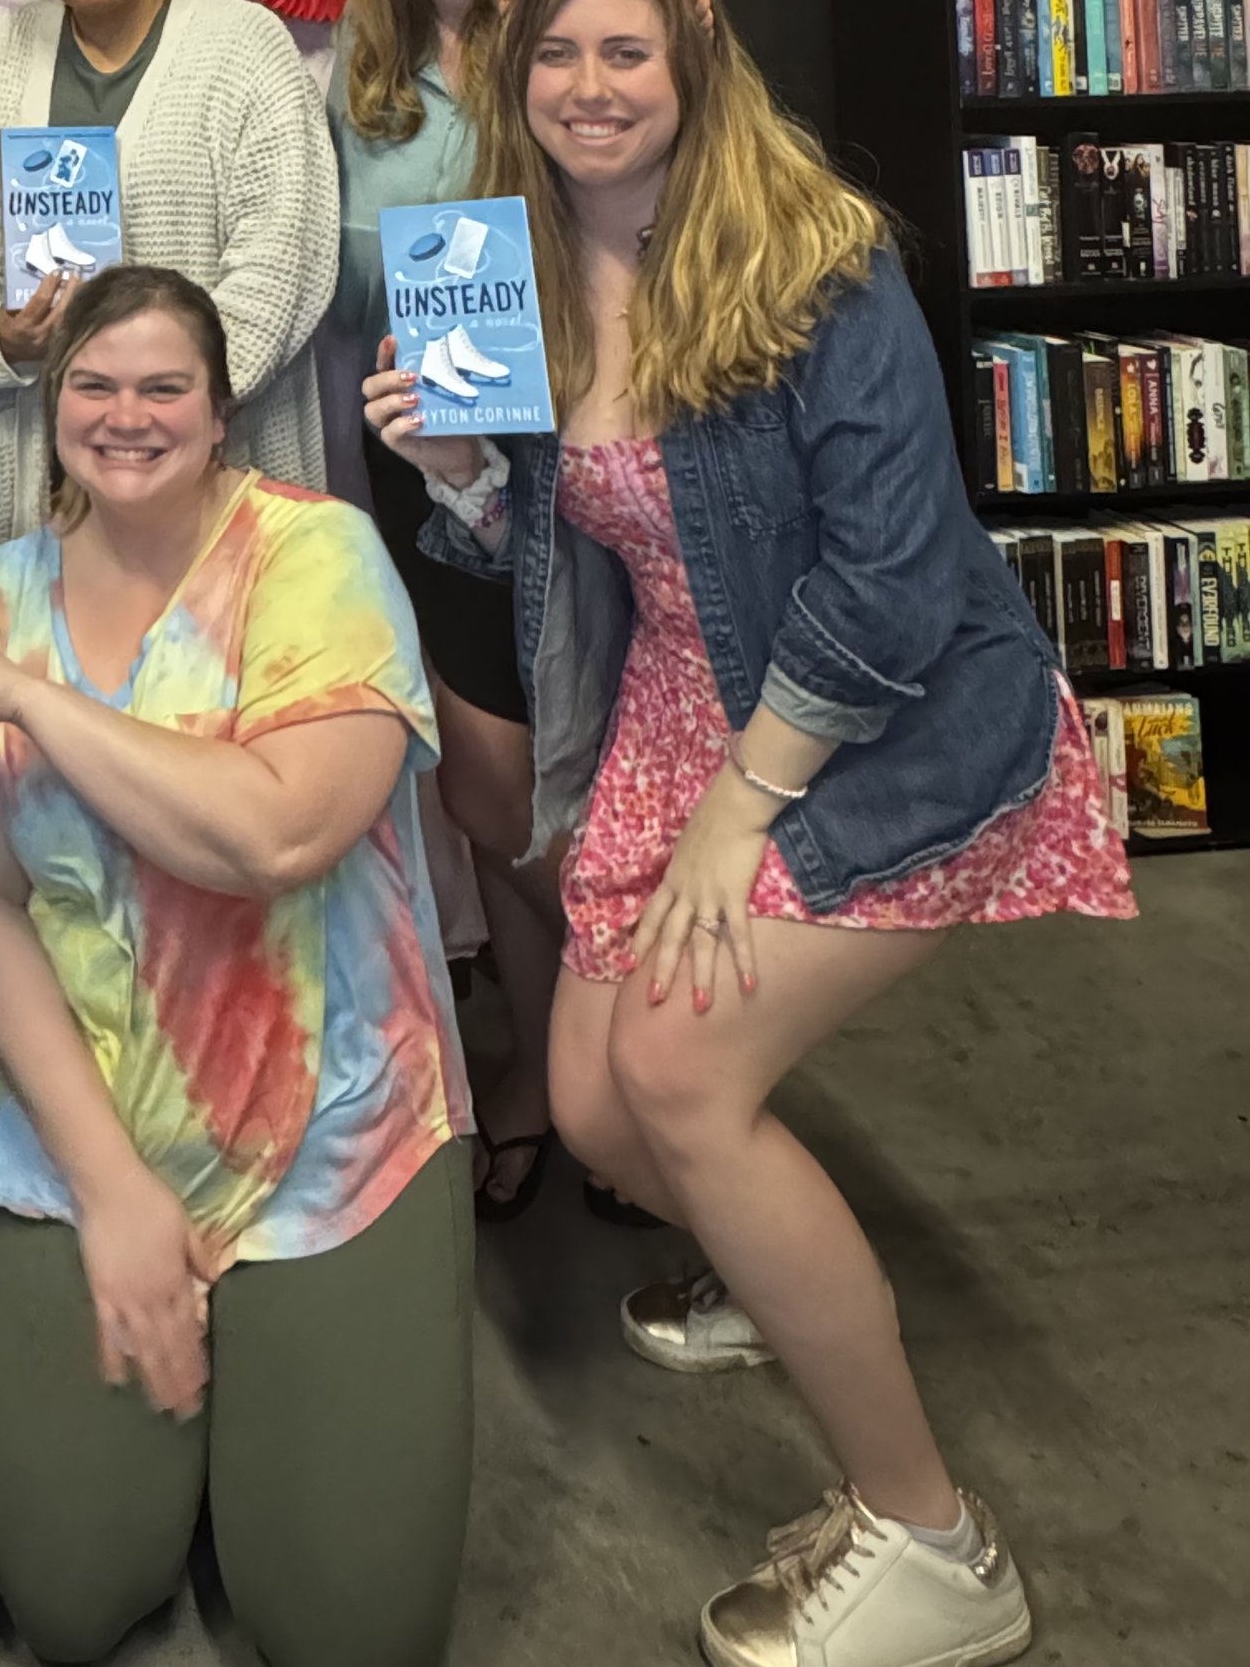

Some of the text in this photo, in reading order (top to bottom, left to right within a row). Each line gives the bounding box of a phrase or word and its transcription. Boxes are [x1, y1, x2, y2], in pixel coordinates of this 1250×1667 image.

[9, 190, 113, 216] UNSTEADY
[395, 280, 526, 318] UNSTEADY
[1148, 380, 1158, 415] ANNA
[421, 406, 541, 424] YTON CORINNE
